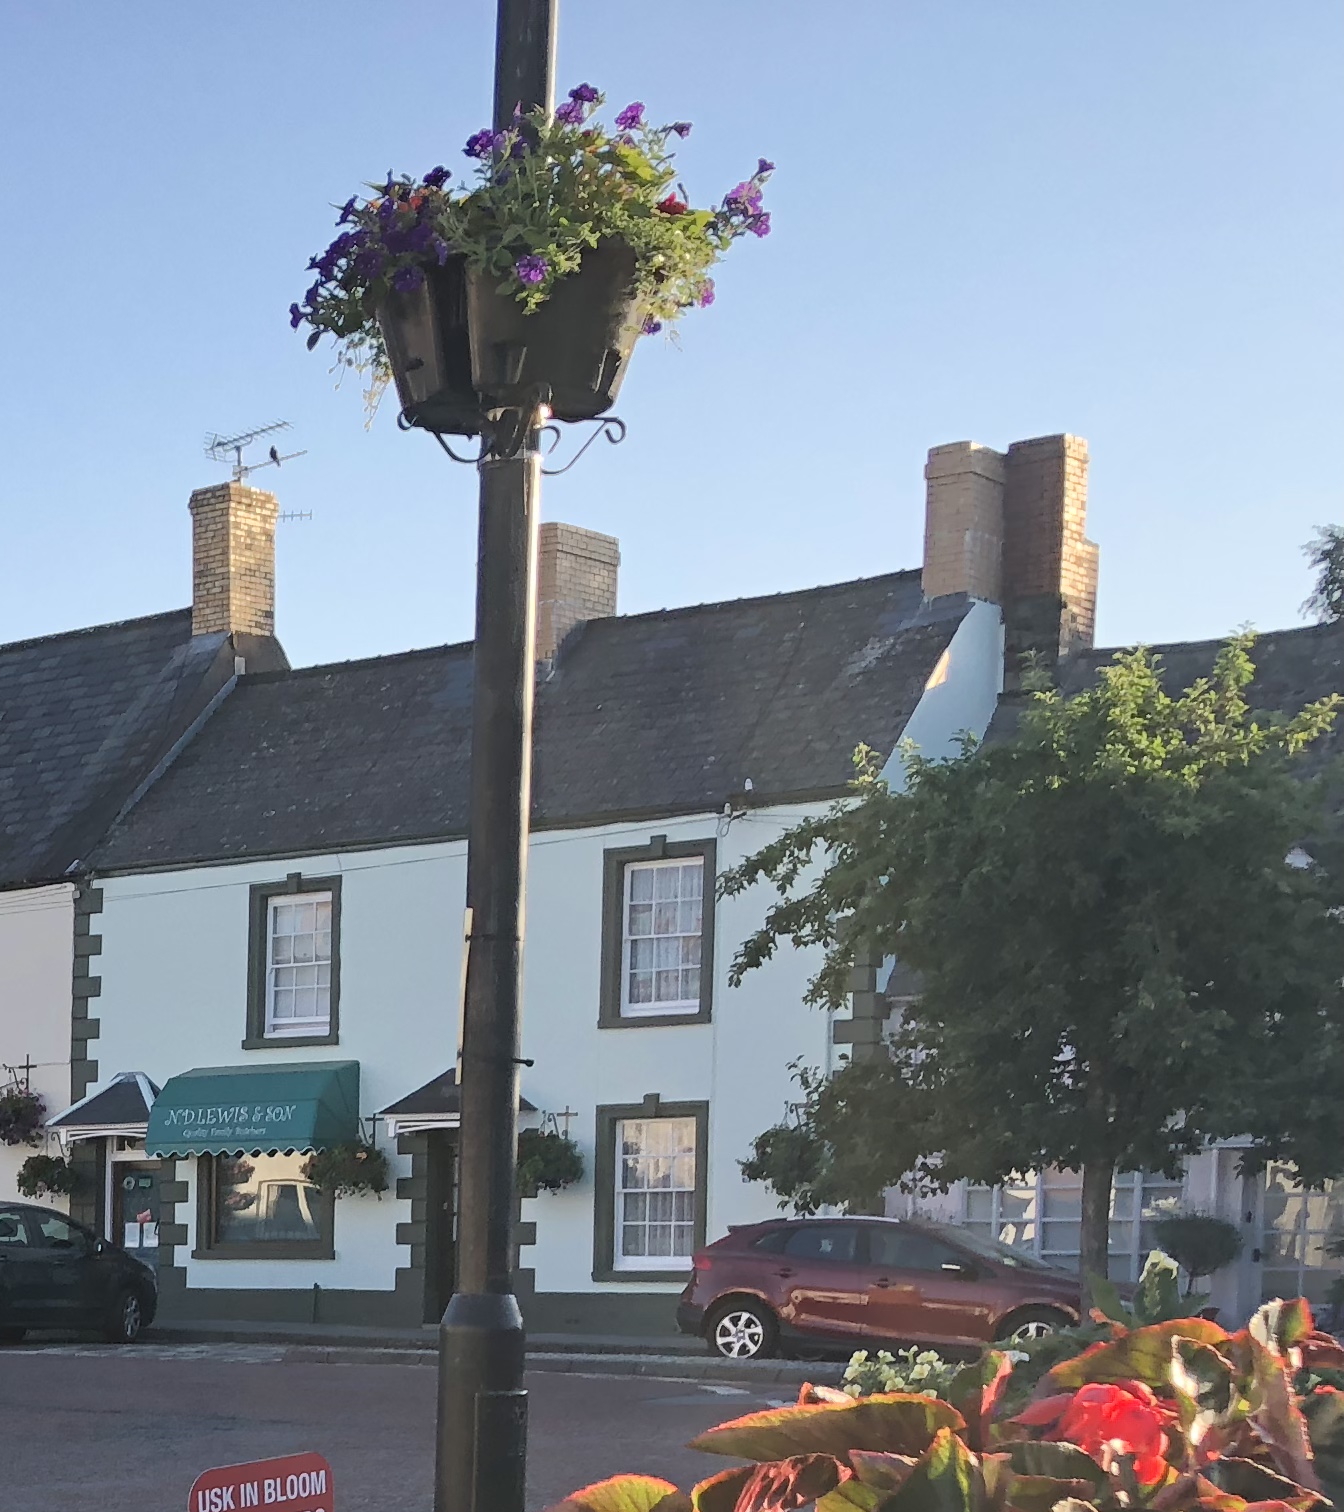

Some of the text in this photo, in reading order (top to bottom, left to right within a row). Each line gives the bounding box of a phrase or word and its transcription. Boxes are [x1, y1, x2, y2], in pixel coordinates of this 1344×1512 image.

[252, 1106, 264, 1122] &
[266, 1105, 296, 1122] SON
[240, 1480, 259, 1508] IN
[264, 1469, 327, 1505] BLOOM
